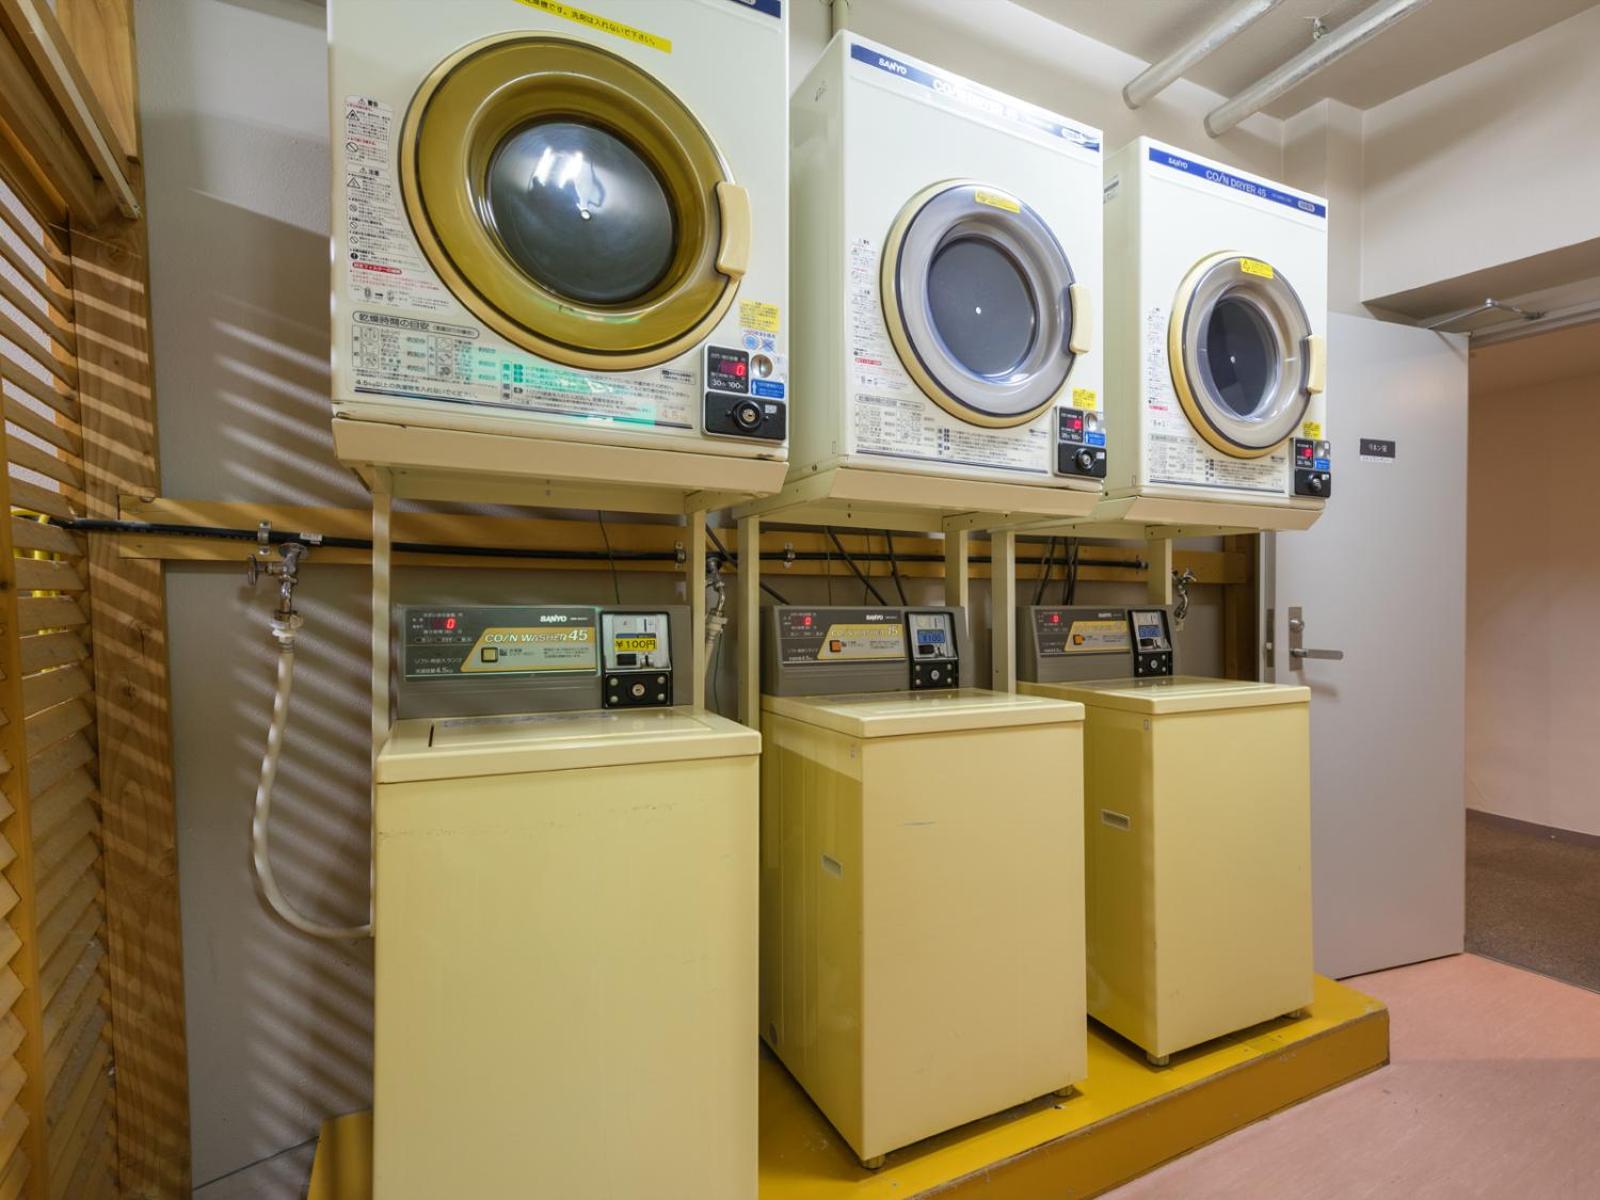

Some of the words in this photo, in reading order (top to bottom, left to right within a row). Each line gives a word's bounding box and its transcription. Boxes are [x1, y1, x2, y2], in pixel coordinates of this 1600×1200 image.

[879, 58, 907, 75] SANYO
[1230, 179, 1256, 194] DRYER
[1257, 187, 1267, 198] 45
[446, 618, 456, 629] 0
[540, 614, 567, 623] SANYO
[568, 628, 589, 641] 45
